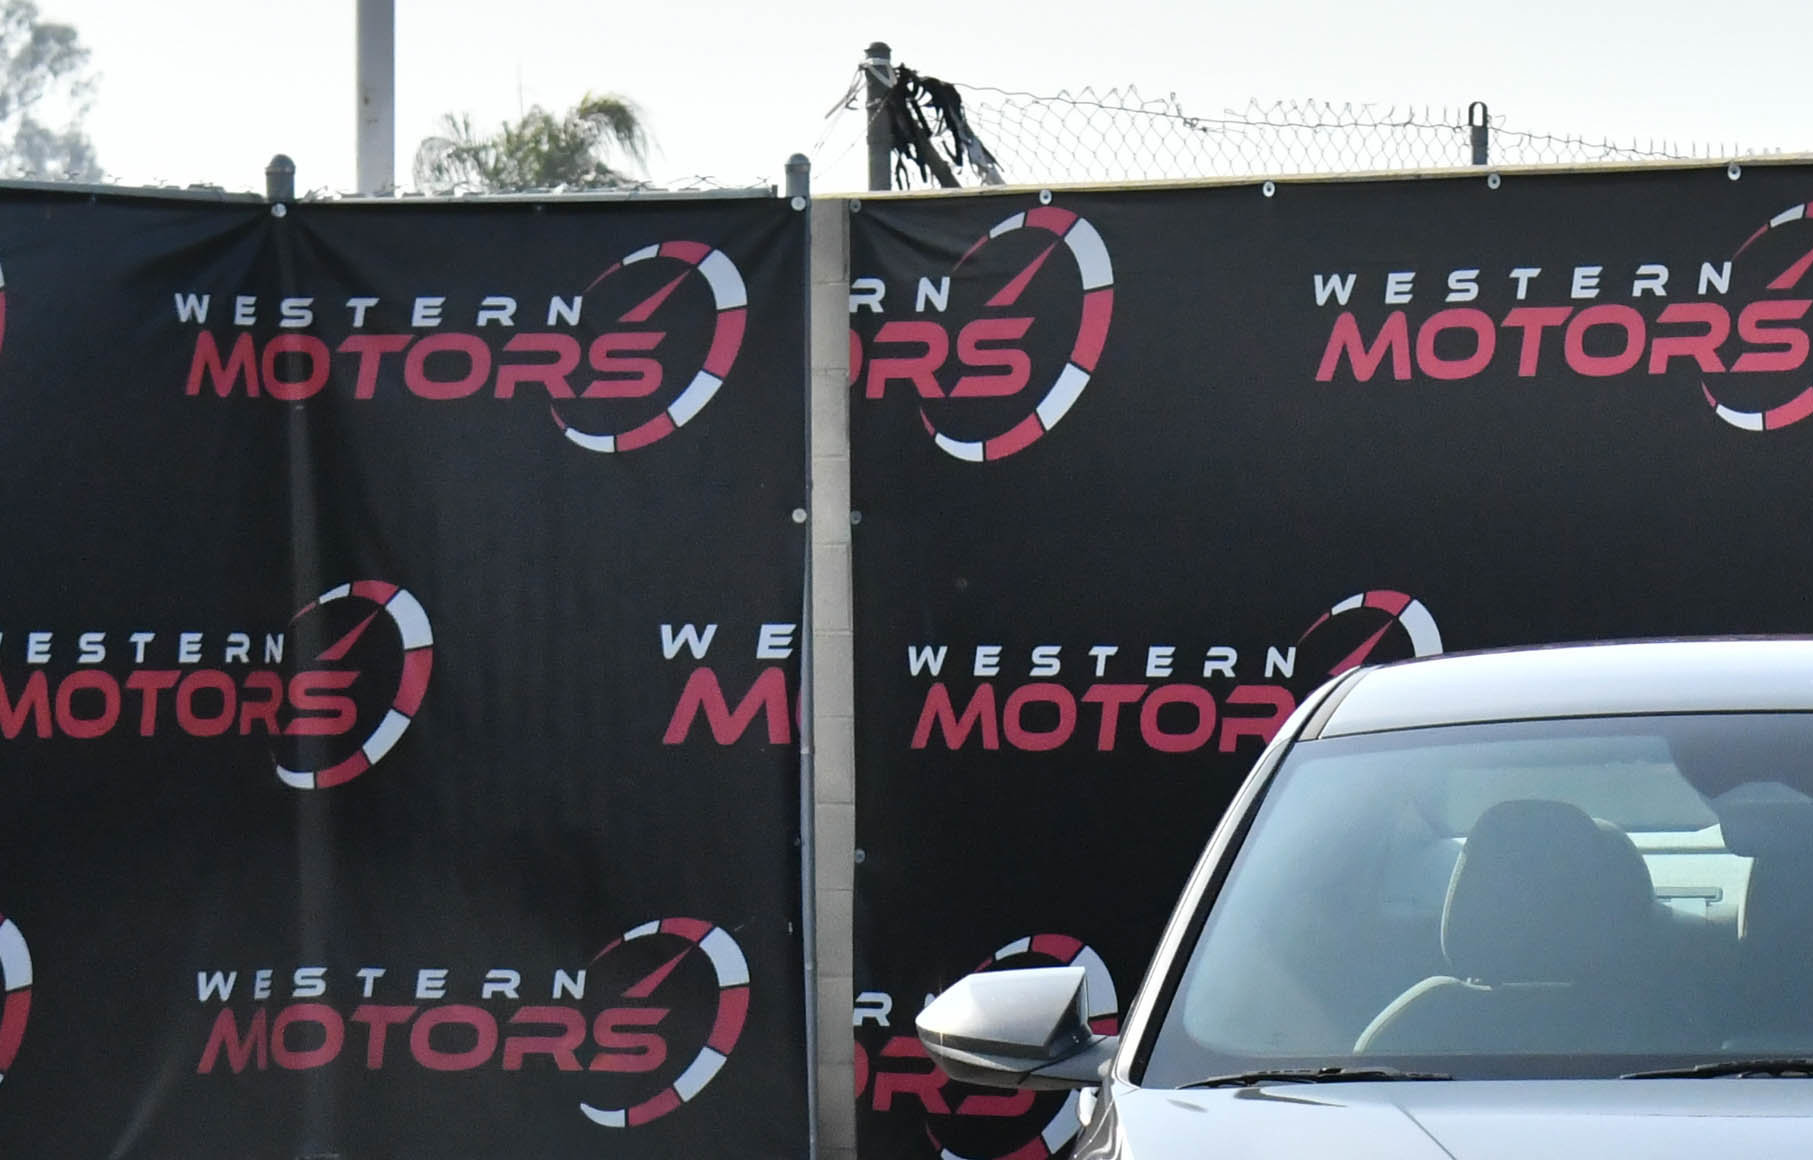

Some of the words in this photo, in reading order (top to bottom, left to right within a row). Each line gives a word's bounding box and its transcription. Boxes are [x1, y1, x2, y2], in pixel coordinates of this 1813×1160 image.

[174, 293, 583, 328] WESTERN
[1313, 260, 1732, 306] WESTERN
[185, 330, 666, 400] MOTORS
[849, 317, 1036, 399] RS
[1315, 299, 1813, 382] MOTORS
[0, 632, 284, 664] ESTERN
[908, 645, 1296, 678] WESTERN
[0, 669, 360, 740] MOTORS
[662, 667, 801, 745] M
[911, 682, 1297, 753] MOTOR
[197, 967, 586, 1002] WESTERN
[199, 1003, 669, 1073] MOTORS
